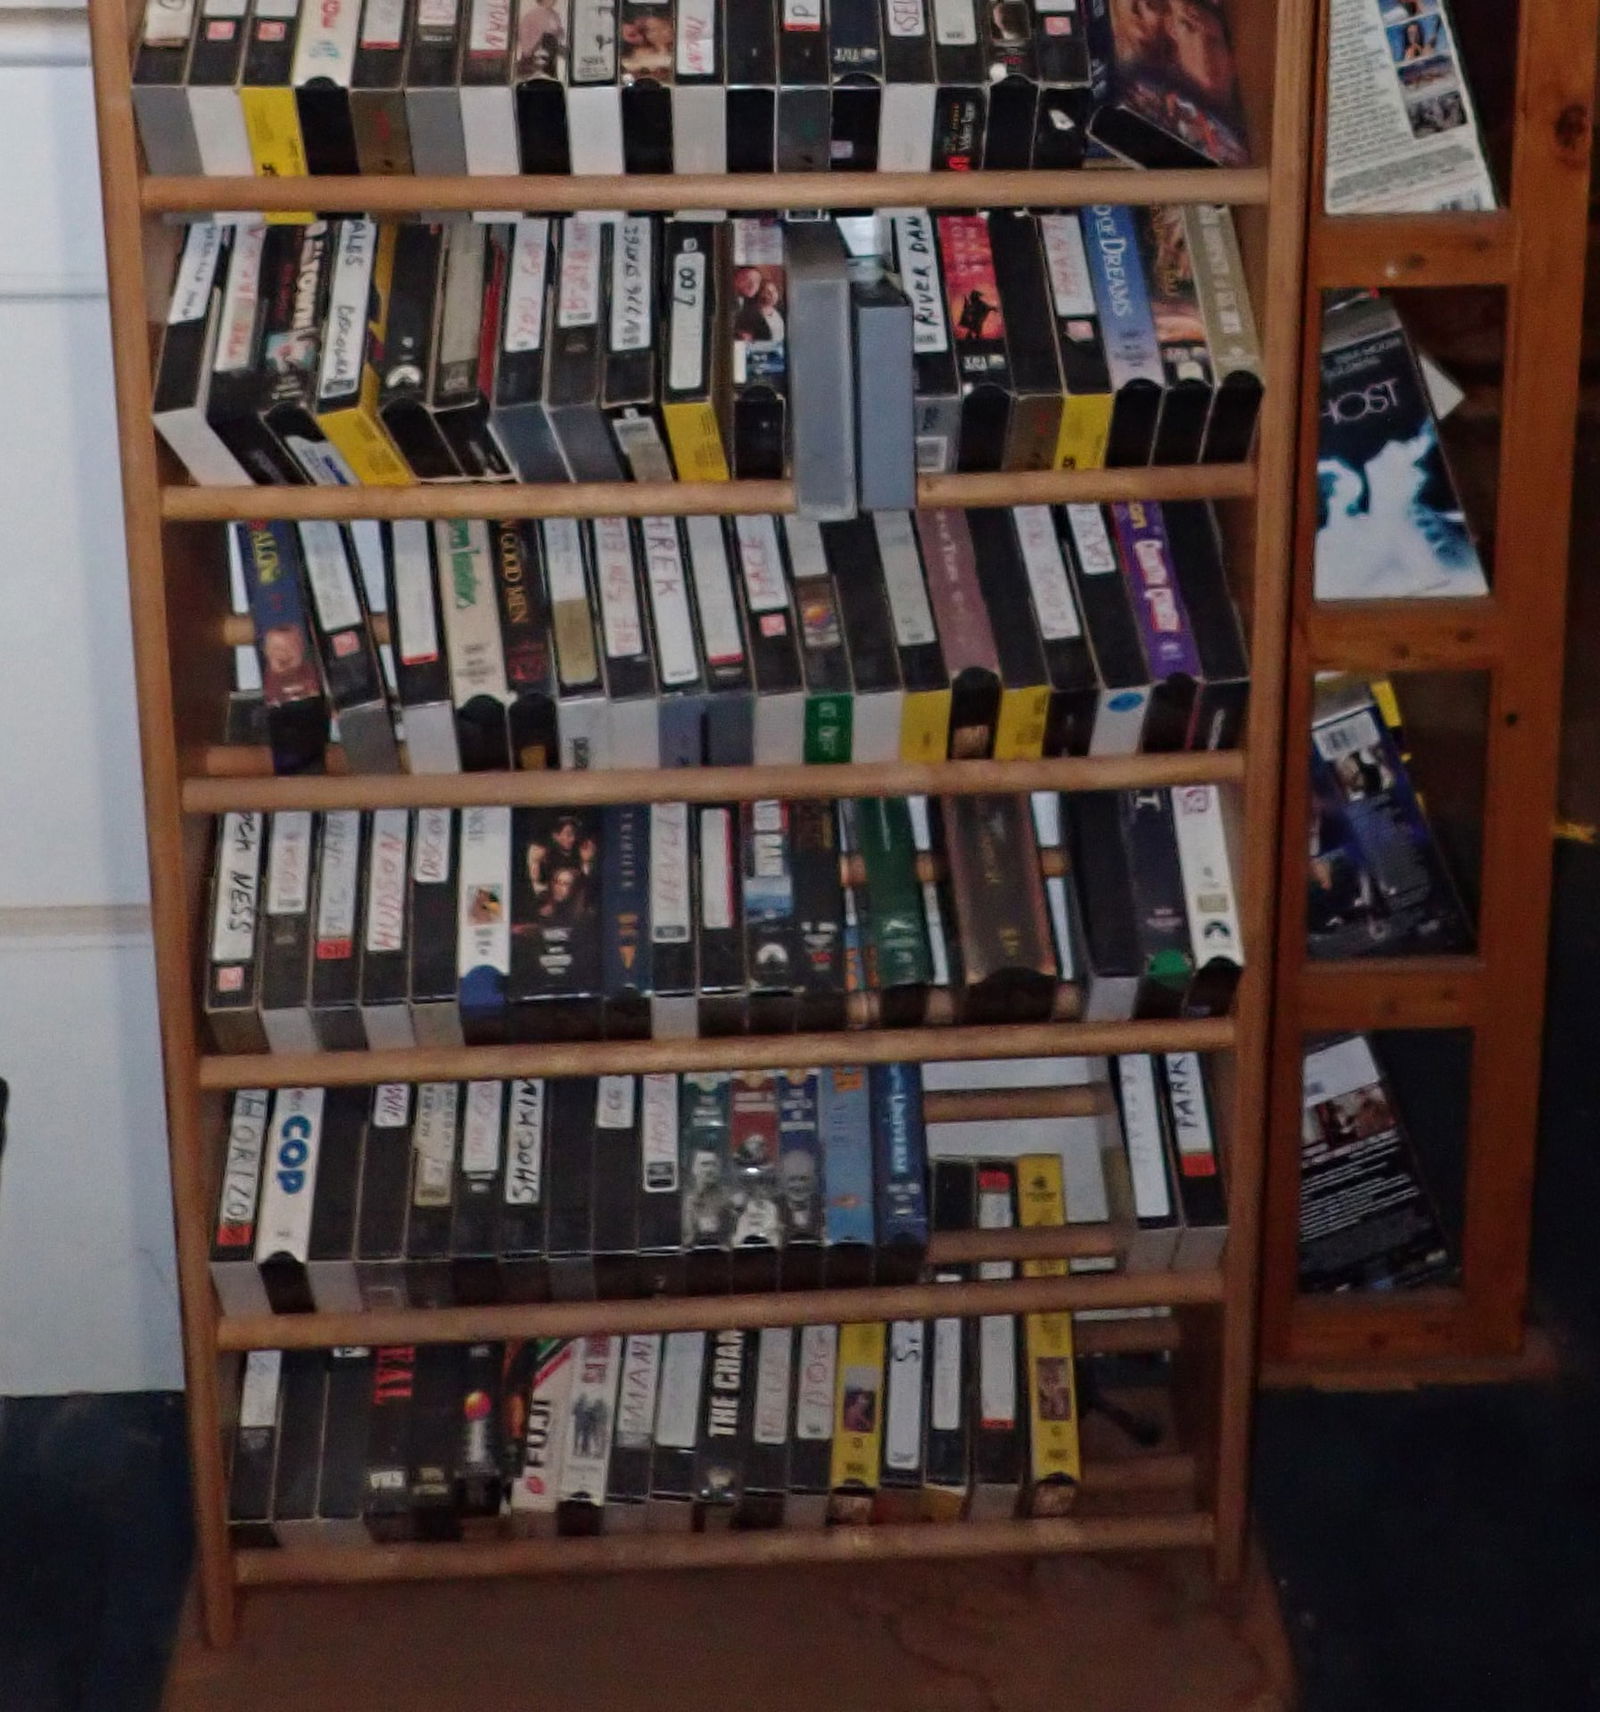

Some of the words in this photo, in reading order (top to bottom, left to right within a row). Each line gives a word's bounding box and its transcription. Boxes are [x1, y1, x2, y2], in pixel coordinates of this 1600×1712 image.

[914, 268, 939, 326] RIVER
[1100, 238, 1133, 318] DREAMS
[276, 1114, 312, 1195] COP
[526, 1397, 555, 1468] FUJI
[708, 1395, 738, 1438] THE
